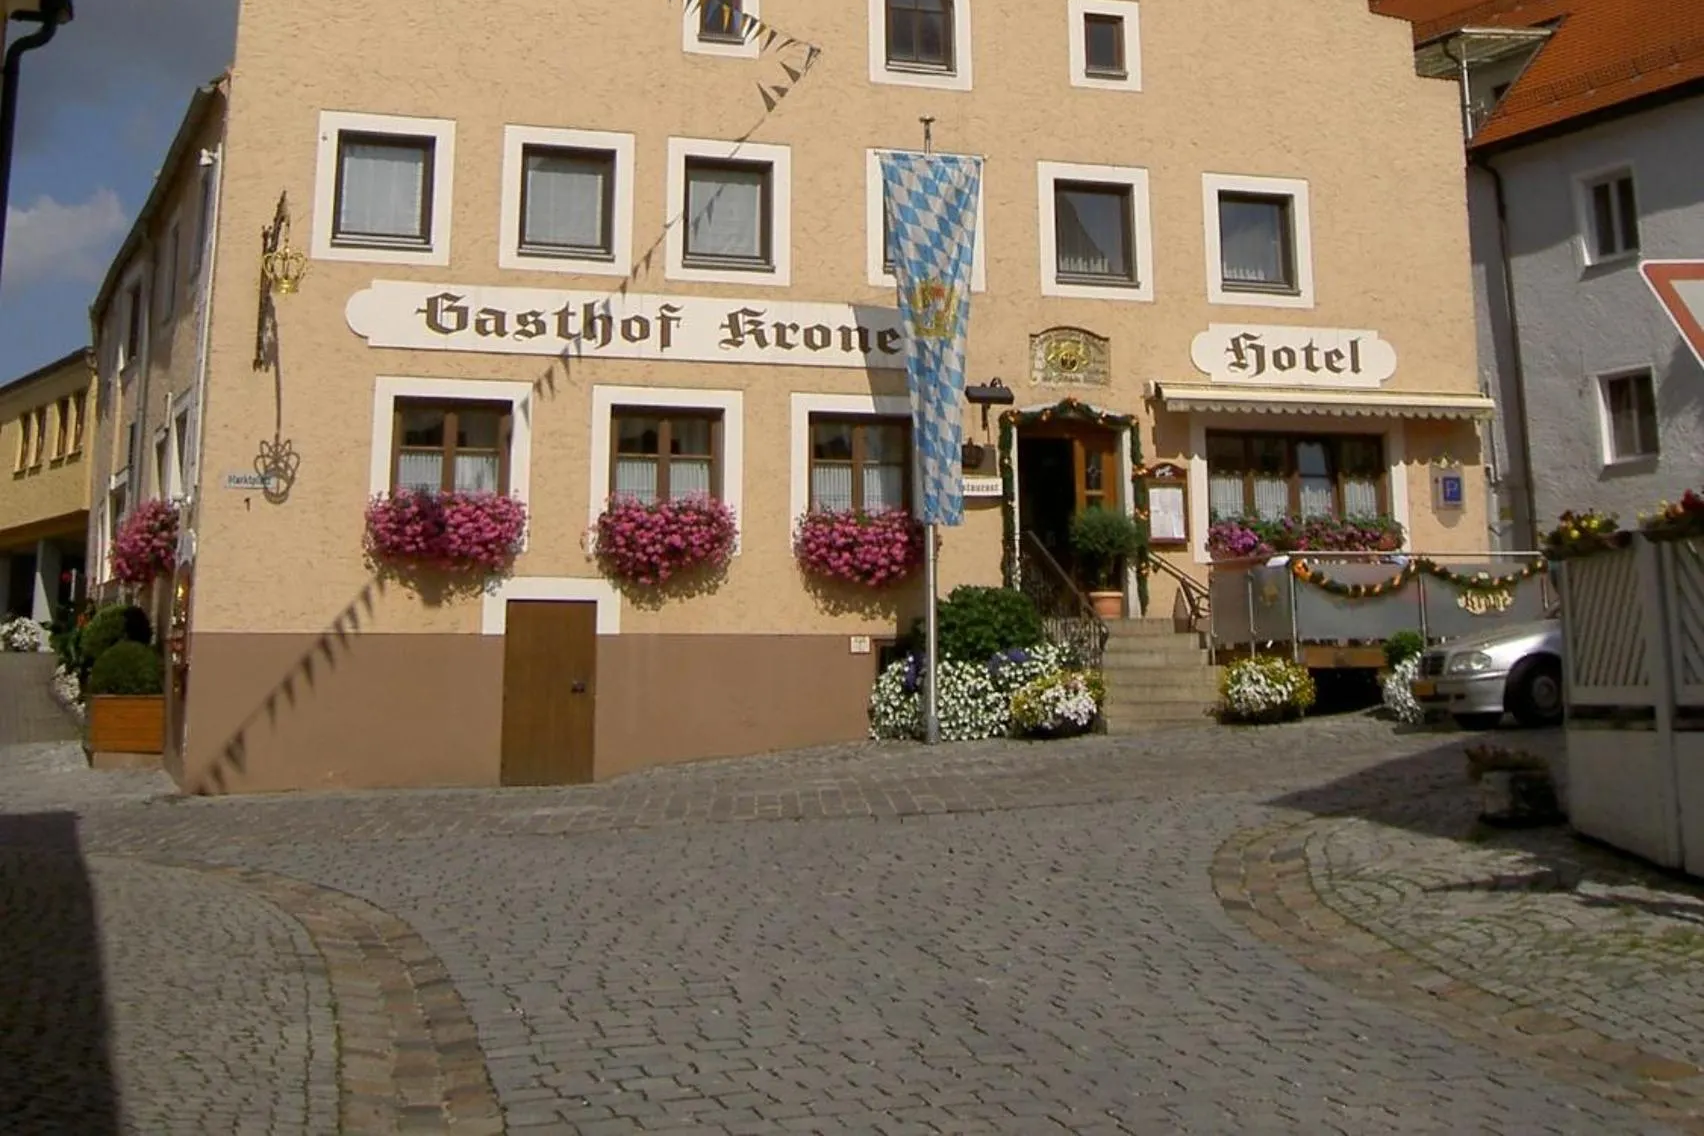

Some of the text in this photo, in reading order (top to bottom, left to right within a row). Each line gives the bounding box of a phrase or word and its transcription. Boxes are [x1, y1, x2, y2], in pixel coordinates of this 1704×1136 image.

[415, 291, 902, 355] Gasthof Krone
[1224, 332, 1361, 378] Hotel
[243, 497, 251, 512] 1
